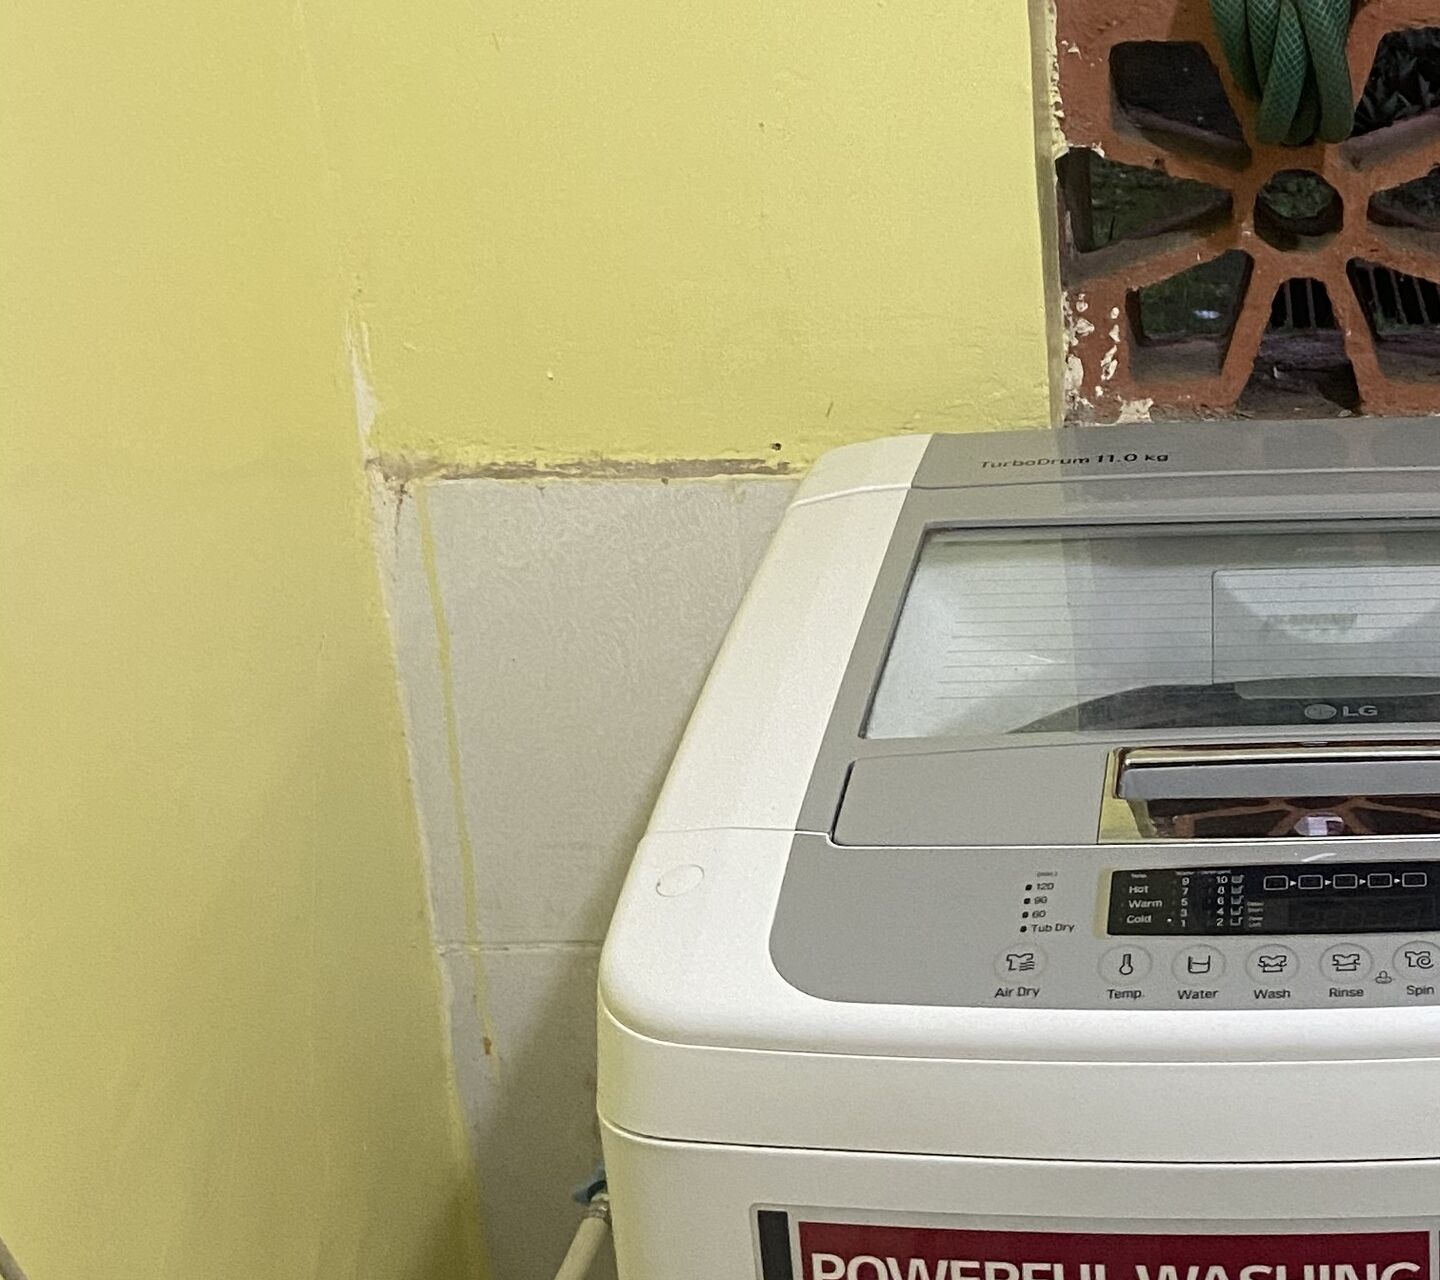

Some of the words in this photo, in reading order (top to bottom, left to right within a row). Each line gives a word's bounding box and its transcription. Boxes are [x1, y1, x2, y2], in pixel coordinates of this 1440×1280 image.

[981, 456, 1090, 469] TurboDrum
[1097, 453, 1138, 463] 11.0
[1144, 453, 1169, 463] kg
[1342, 705, 1378, 717] LG
[1216, 875, 1228, 884] 10
[1036, 882, 1055, 891] 120
[1128, 885, 1149, 894] Hot
[1128, 899, 1163, 909] Warm
[1216, 897, 1224, 905] 6
[1216, 907, 1224, 915] 4
[1126, 915, 1152, 924] Cold
[1216, 918, 1223, 926] 2
[1031, 924, 1053, 933] Tub
[1055, 923, 1075, 933] Dry
[994, 987, 1013, 998] Air
[1017, 986, 1040, 998] Dry
[1177, 989, 1219, 999] Water
[1253, 989, 1291, 999] Wash
[1328, 987, 1365, 998] Rinse
[1406, 985, 1435, 997] Spin
